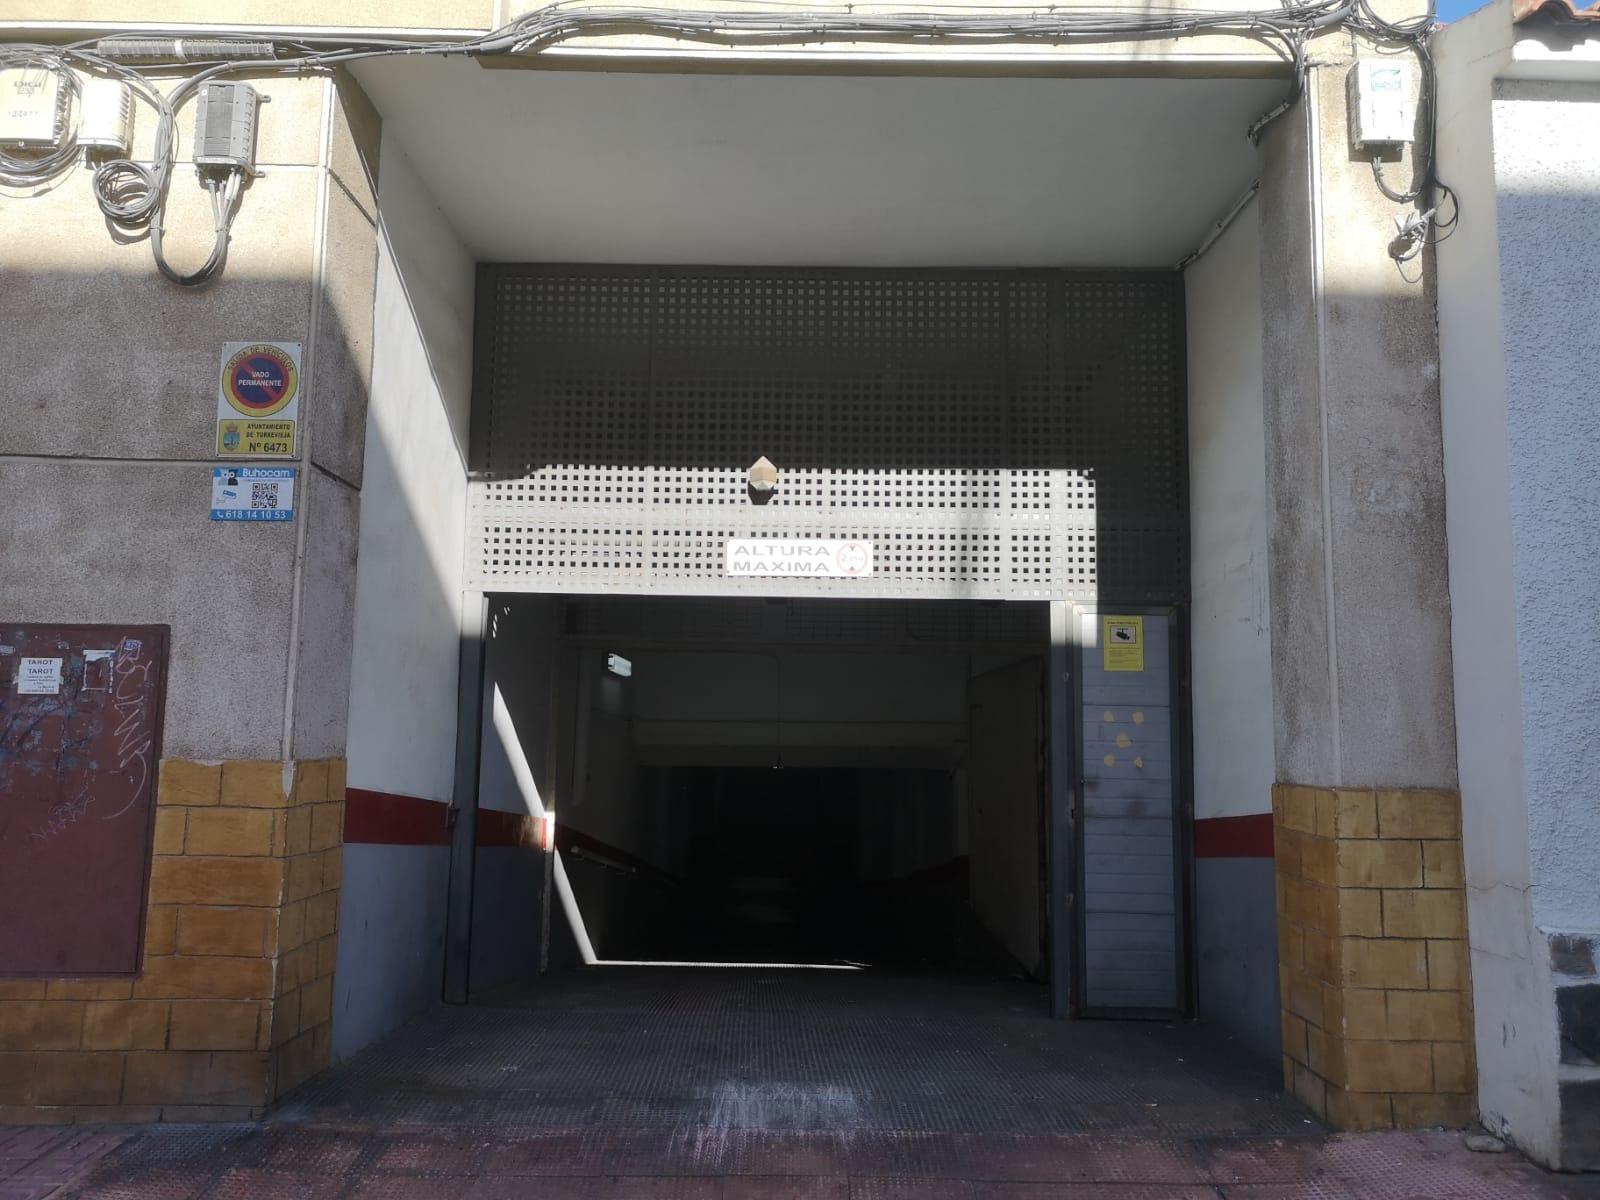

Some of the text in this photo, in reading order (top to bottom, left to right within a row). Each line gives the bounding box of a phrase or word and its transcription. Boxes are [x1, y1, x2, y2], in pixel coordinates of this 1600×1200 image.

[227, 349, 249, 370] SALIDA
[250, 346, 260, 354] DE
[263, 442, 288, 452] 6473
[242, 468, 290, 477] Buhocam
[225, 510, 286, 519] 618 14 10 53
[734, 545, 831, 556] ALTURA
[733, 561, 830, 572] MAXIMA
